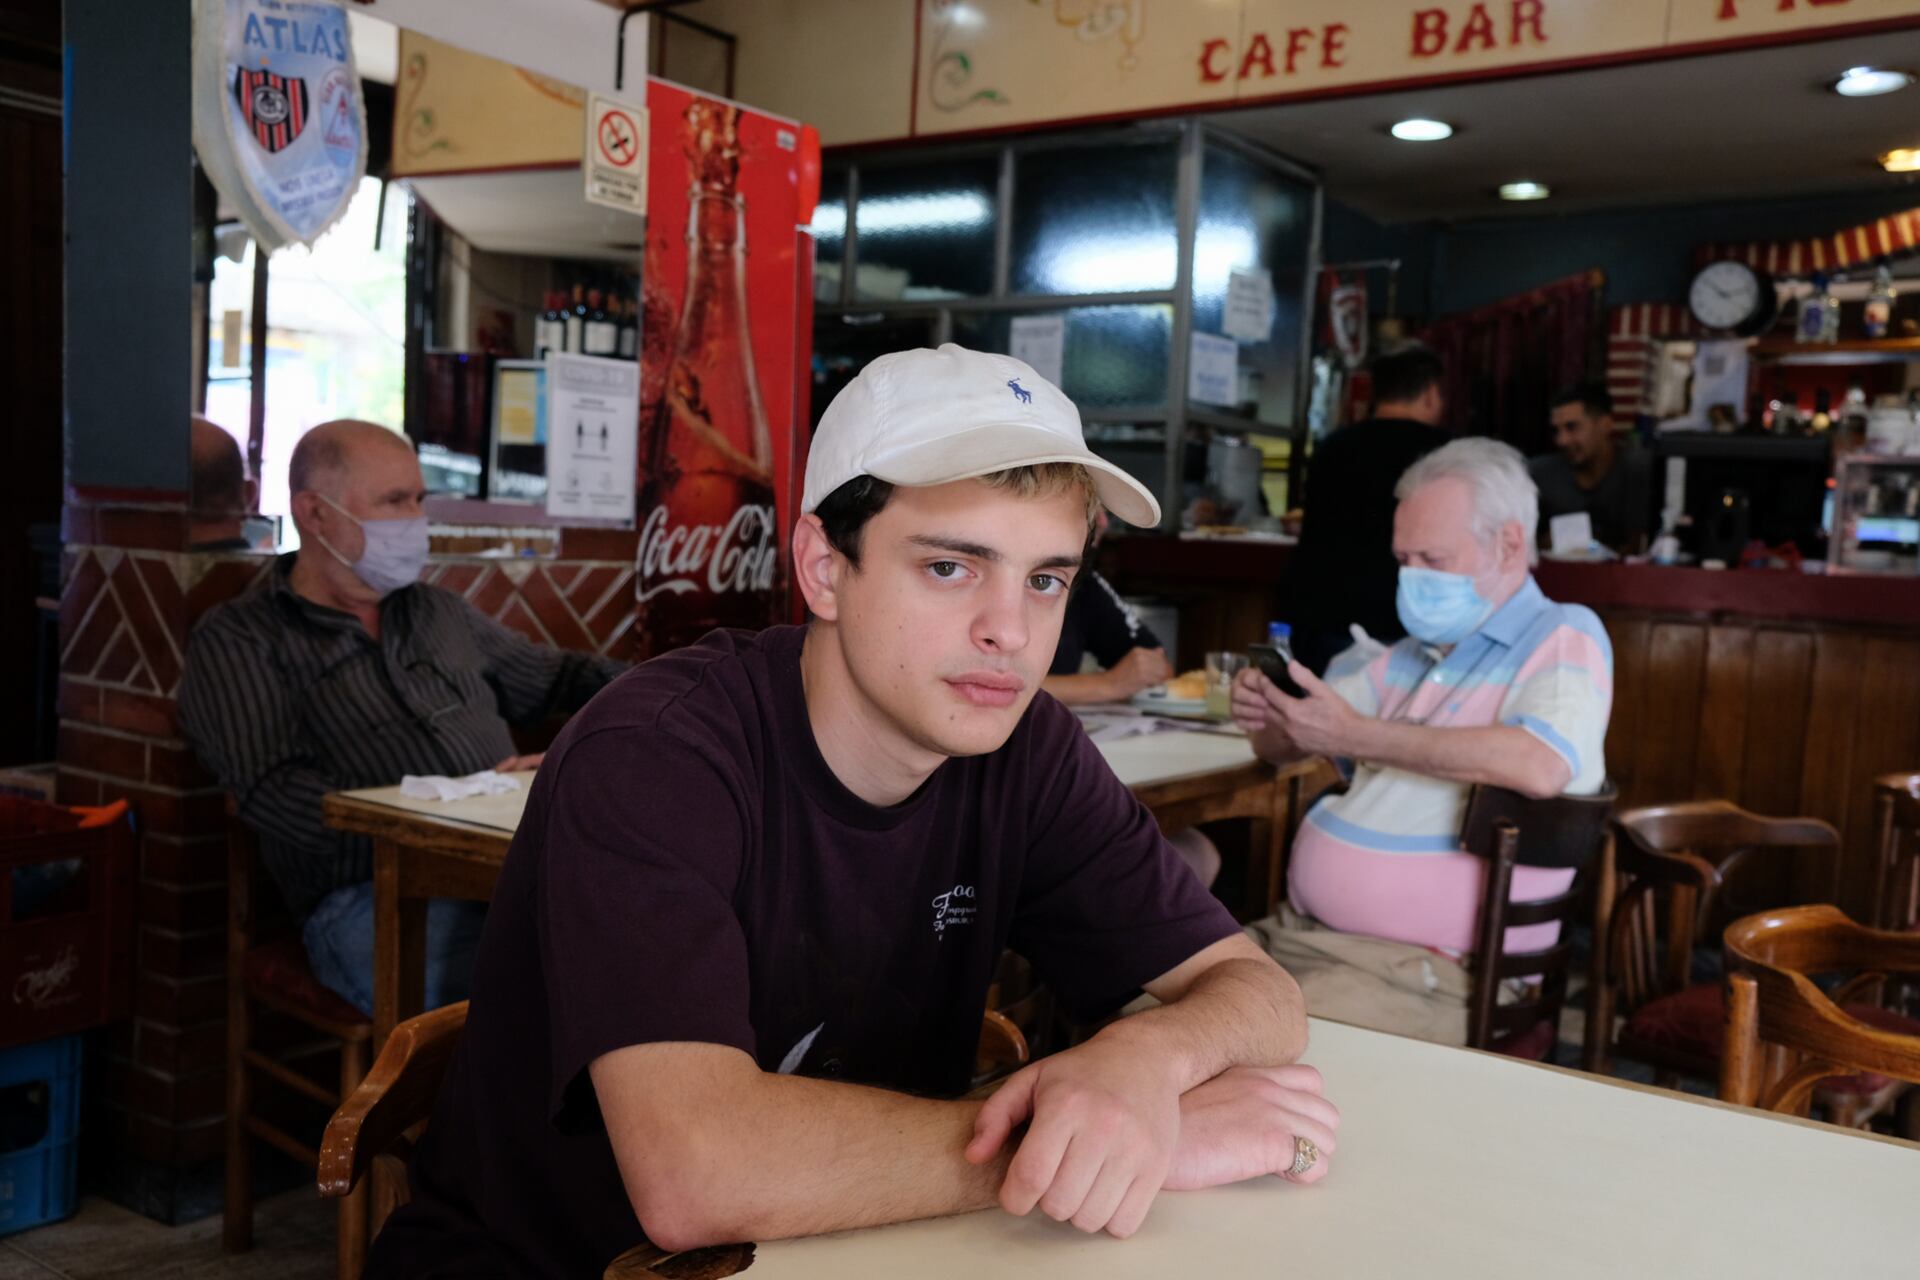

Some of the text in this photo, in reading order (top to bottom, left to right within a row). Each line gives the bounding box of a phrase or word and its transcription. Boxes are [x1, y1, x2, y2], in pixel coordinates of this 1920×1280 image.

[243, 12, 347, 62] ATLAS
[1197, 0, 1548, 84] CAFE BAR
[635, 504, 777, 603] Coca-Cola
